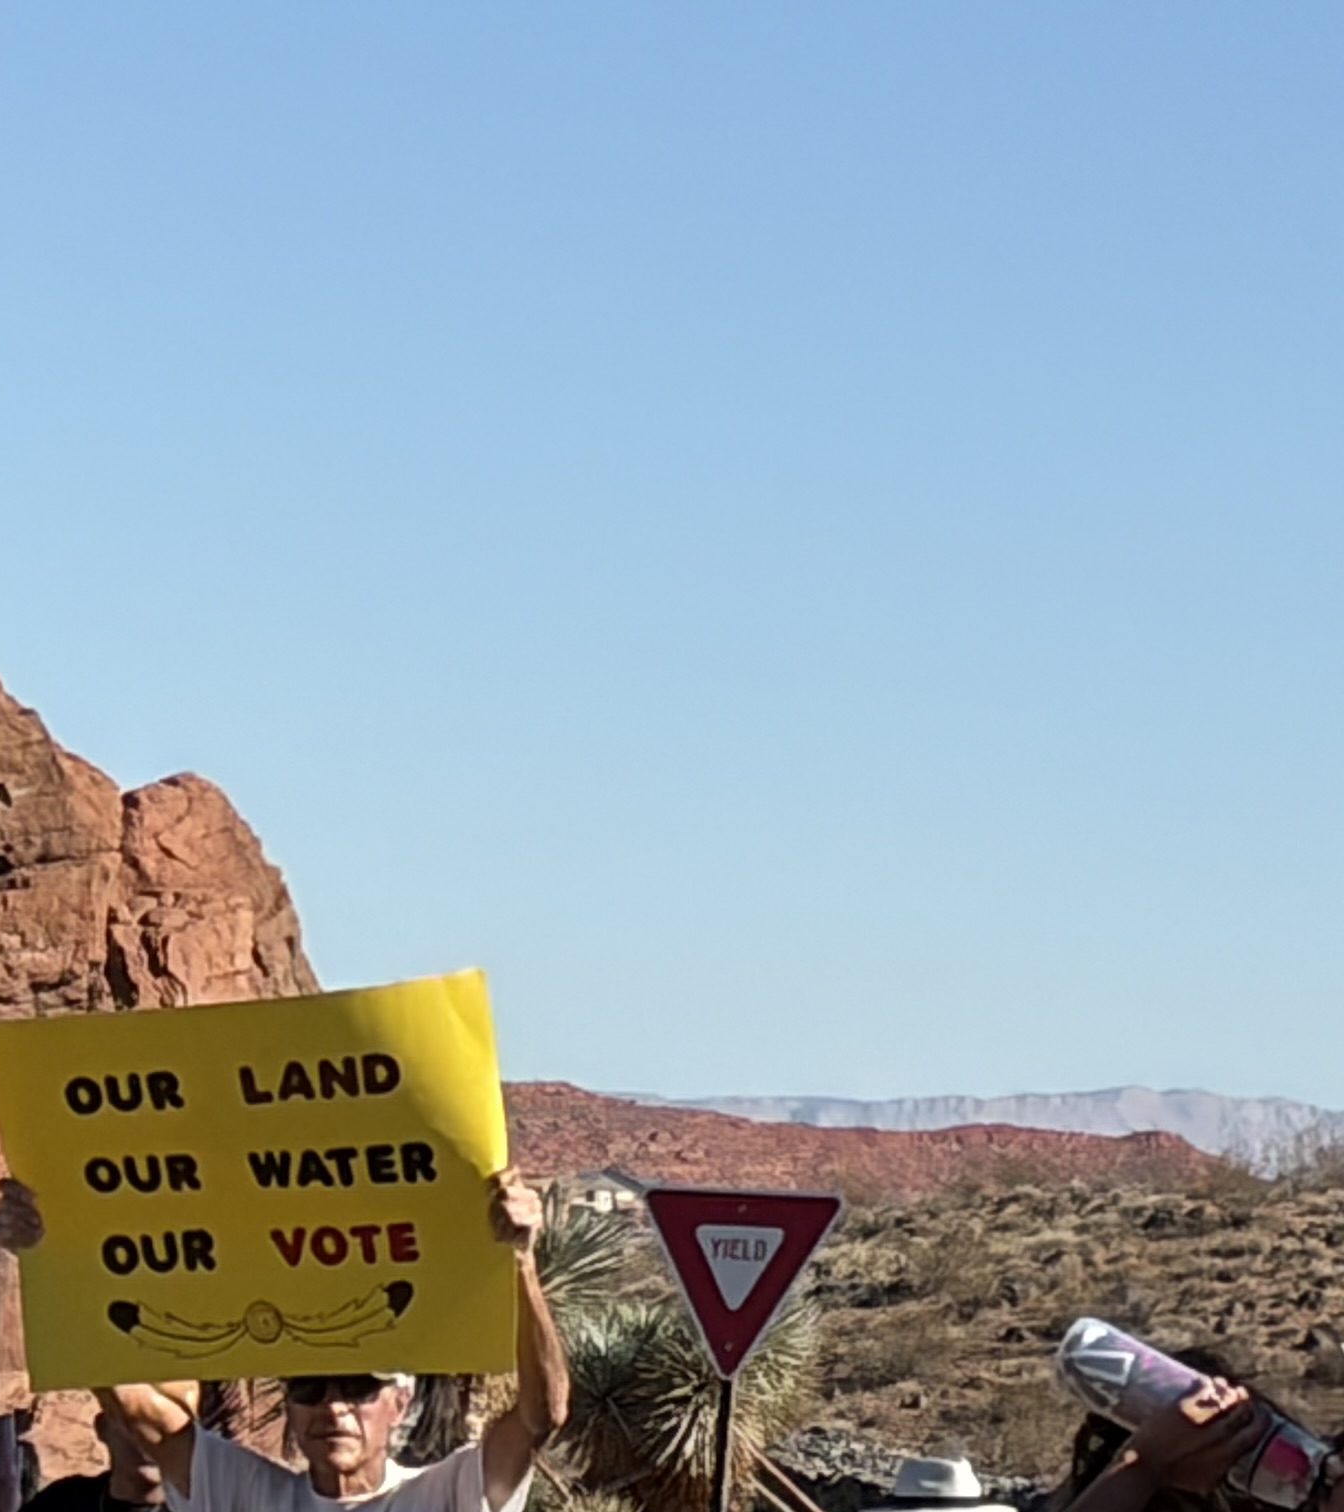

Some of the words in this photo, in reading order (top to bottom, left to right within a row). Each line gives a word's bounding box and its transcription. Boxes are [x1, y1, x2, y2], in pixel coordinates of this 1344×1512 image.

[64, 1070, 185, 1115] OUR
[239, 1053, 401, 1106] LAND
[84, 1154, 202, 1193] OUR
[248, 1142, 438, 1189] WATER
[101, 1229, 216, 1275] OUR
[270, 1222, 420, 1267] VOTE
[710, 1237, 767, 1262] YIELD
